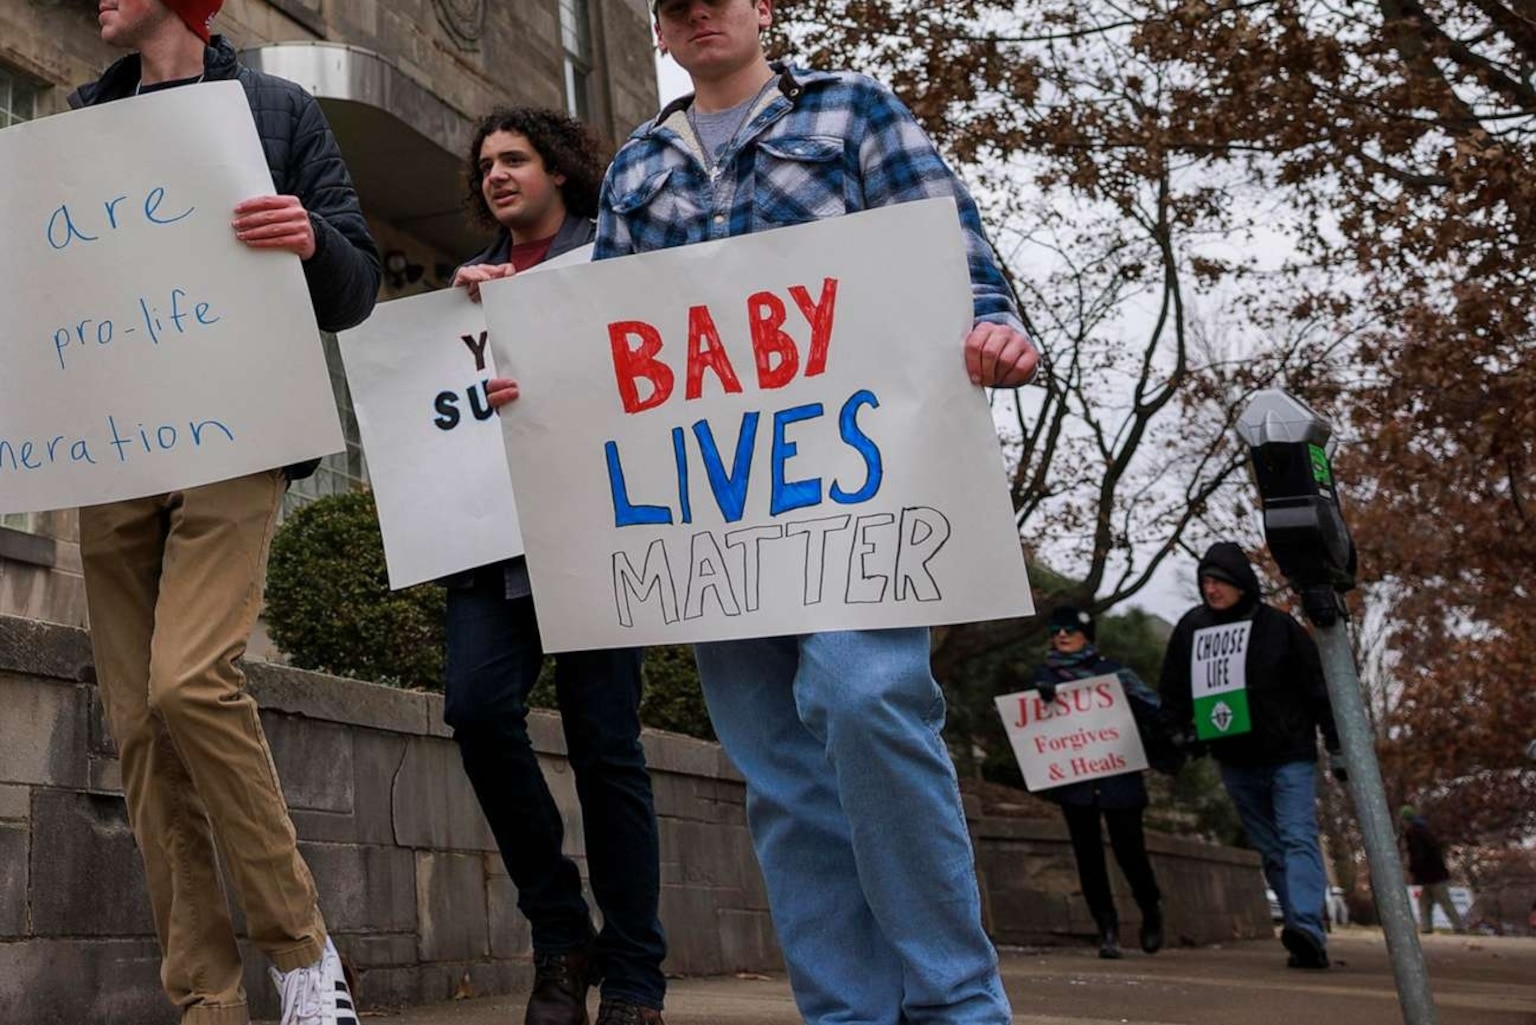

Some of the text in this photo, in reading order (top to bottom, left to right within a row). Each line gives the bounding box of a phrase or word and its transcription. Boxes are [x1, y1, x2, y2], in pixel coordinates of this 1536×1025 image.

[47, 186, 195, 250] are
[52, 288, 220, 370] pro-life
[607, 277, 838, 414] BABY
[433, 378, 500, 431] SU
[604, 389, 884, 528] LIVES
[611, 505, 951, 628] MATTER
[1196, 628, 1246, 661] CHOOSE
[1206, 658, 1229, 688] LIFE
[1015, 682, 1114, 728] JESUS
[1033, 727, 1120, 754] Forgives
[1049, 752, 1127, 781] & Heals
